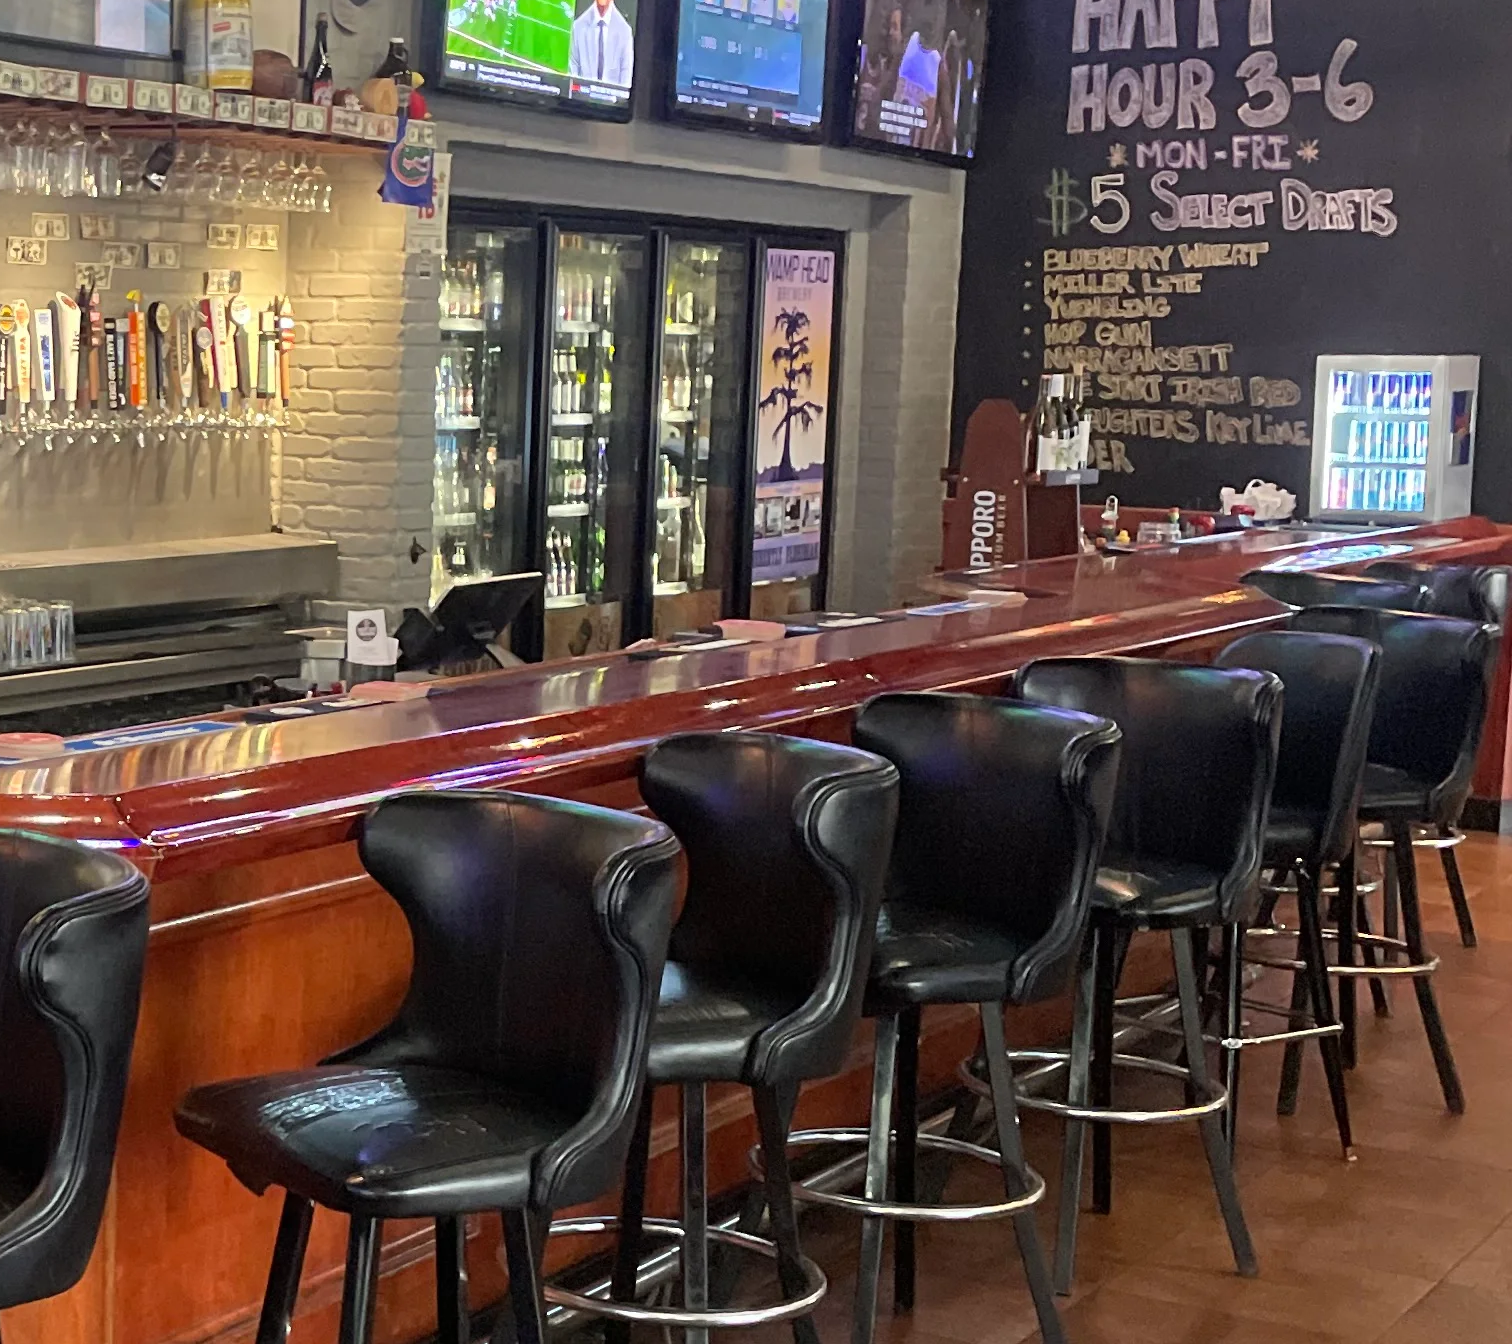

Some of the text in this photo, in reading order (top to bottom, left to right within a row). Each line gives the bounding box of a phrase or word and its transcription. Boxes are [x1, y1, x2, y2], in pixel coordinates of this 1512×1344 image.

[1067, 37, 1374, 134] HOUR 3-6
[801, 256, 830, 284] HEAD
[1043, 242, 1270, 272] BLUEBERRY WHEAT
[1043, 271, 1203, 296] MILLER LITE
[1043, 320, 1153, 347] HOP GUN
[1043, 343, 1234, 373] NARRAGANSETT
[1249, 376, 1301, 408] RED
[969, 489, 996, 569] PPORO
